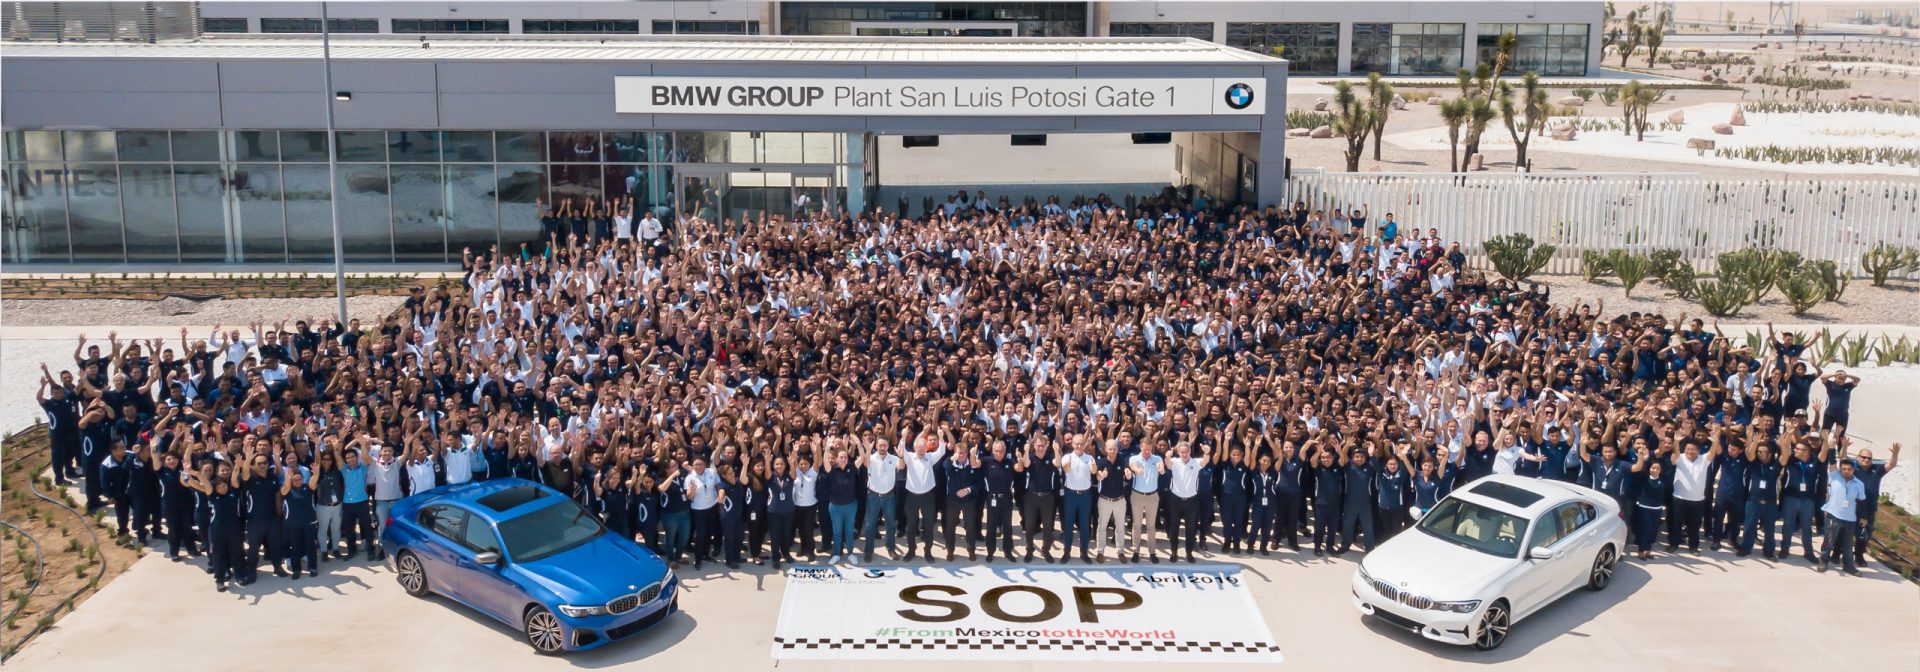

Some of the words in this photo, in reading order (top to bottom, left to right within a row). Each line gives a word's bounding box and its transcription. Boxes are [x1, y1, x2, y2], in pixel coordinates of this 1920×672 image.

[651, 85, 723, 107] BMW
[727, 85, 825, 108] GROUP
[834, 86, 893, 108] Plant
[900, 86, 946, 108] San
[954, 86, 1003, 108] Luis
[1011, 86, 1087, 108] Potosi
[1095, 86, 1155, 108] Gate
[1165, 86, 1175, 107] 1
[1135, 575, 1183, 584] Abril
[1187, 576, 1240, 585] 2019
[896, 584, 1143, 623] SOP
[874, 627, 1177, 640] #FromMexicototheWorld
